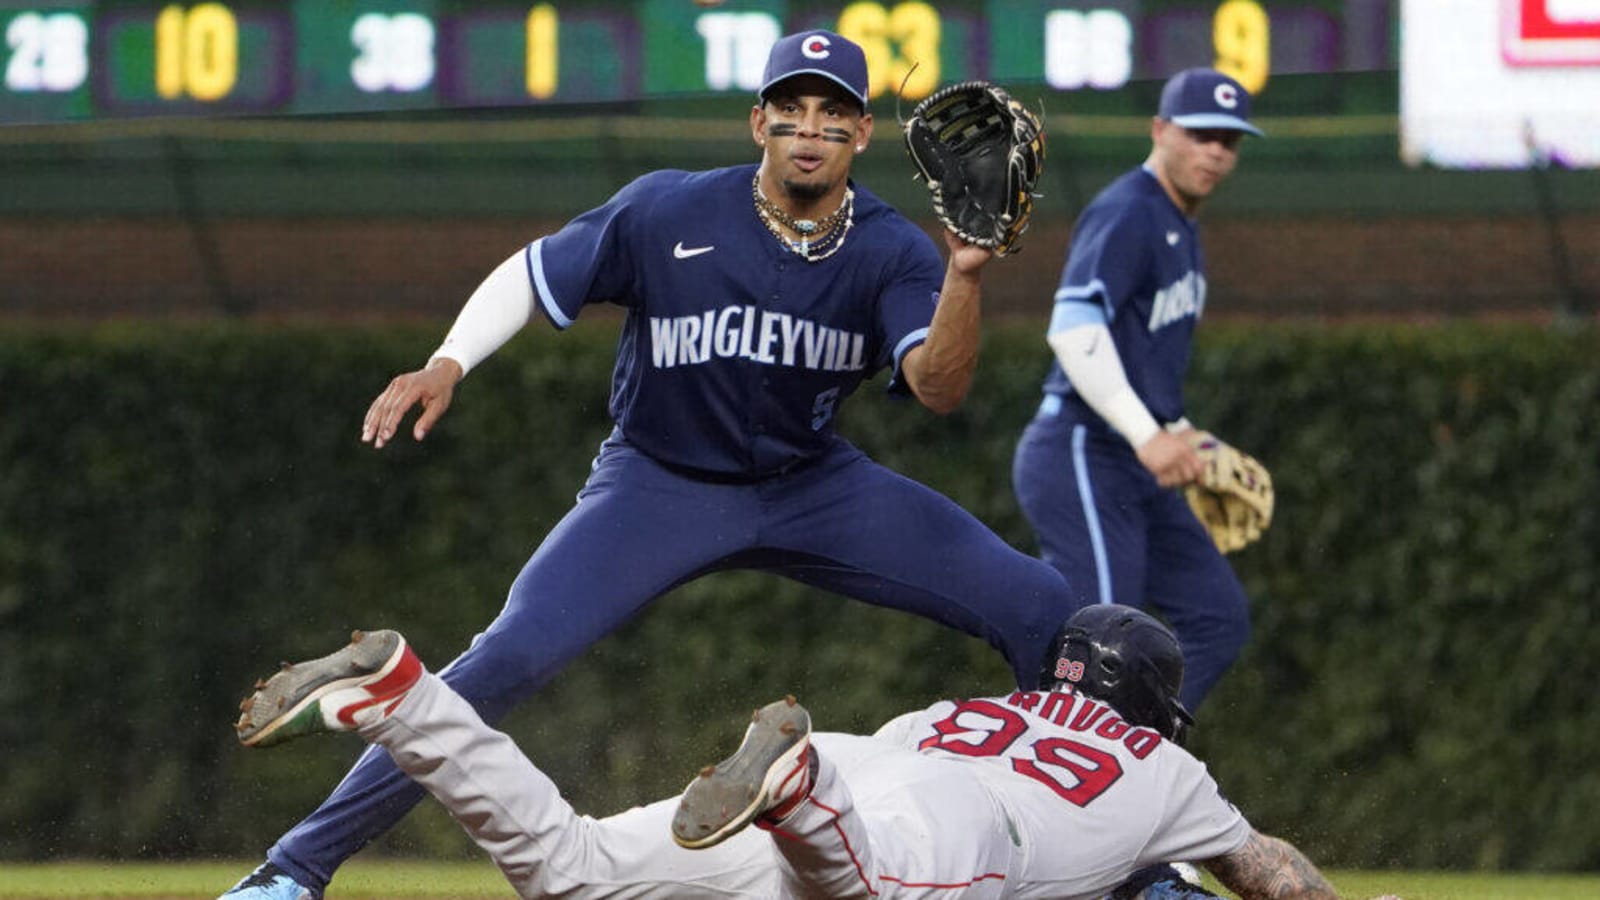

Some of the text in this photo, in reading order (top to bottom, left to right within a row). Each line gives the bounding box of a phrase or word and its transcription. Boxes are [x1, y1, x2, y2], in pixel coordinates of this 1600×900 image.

[155, 3, 239, 100] 10
[526, 3, 558, 99] 1
[838, 1, 942, 100] 63
[1214, 0, 1271, 95] 9
[801, 35, 831, 60] C
[1214, 83, 1238, 109] C
[1054, 657, 1085, 682] 99
[917, 698, 1124, 808] 99
